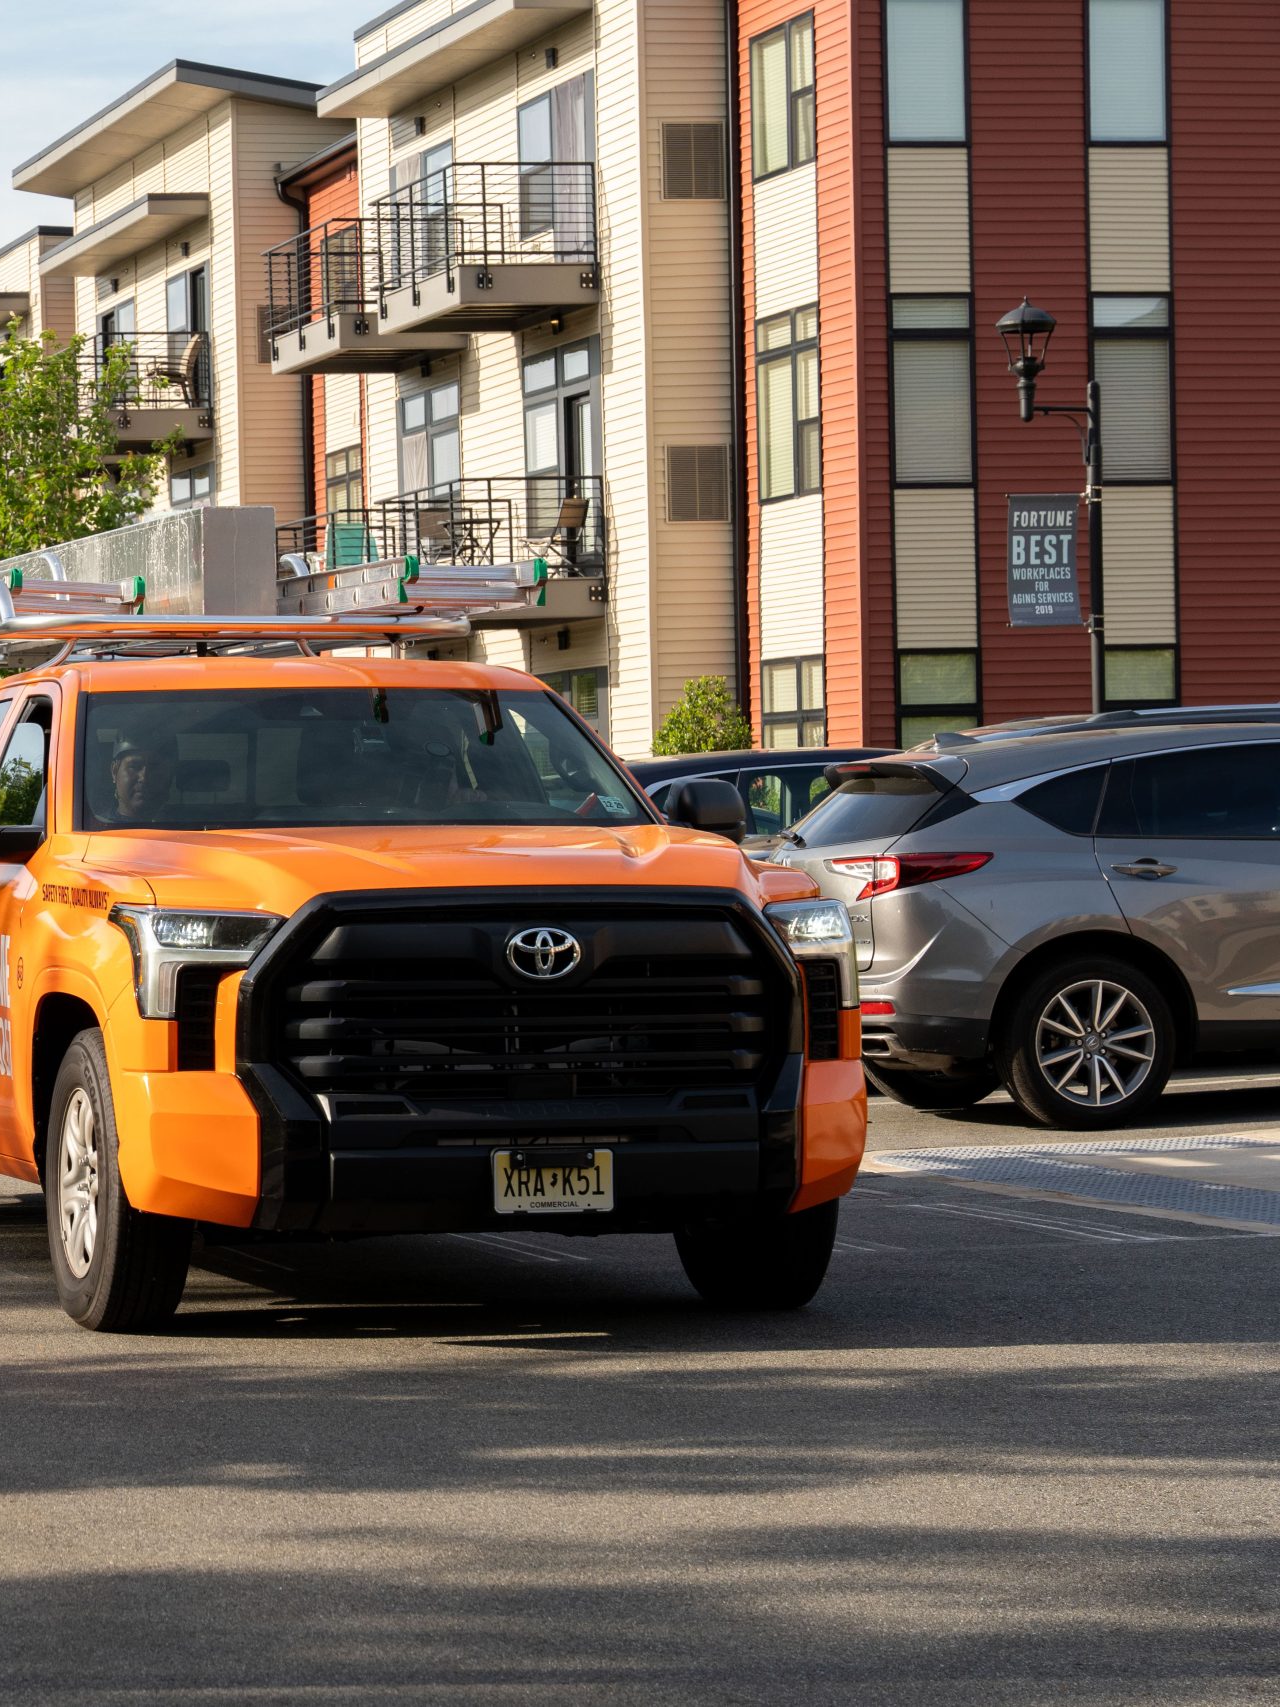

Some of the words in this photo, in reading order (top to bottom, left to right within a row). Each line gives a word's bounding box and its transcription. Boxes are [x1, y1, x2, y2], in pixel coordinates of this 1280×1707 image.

[1013, 511, 1073, 527] FORTUNE
[1012, 534, 1072, 565] BEST
[1012, 567, 1071, 580] WORKPLACES
[1035, 581, 1049, 591] FOR
[1012, 594, 1036, 604] AGING
[1038, 592, 1074, 603] SERVICES
[1035, 605, 1053, 614] 2019
[503, 1167, 546, 1198] XRA
[562, 1165, 605, 1196] K51
[530, 1201, 579, 1209] COMMERCIAL
